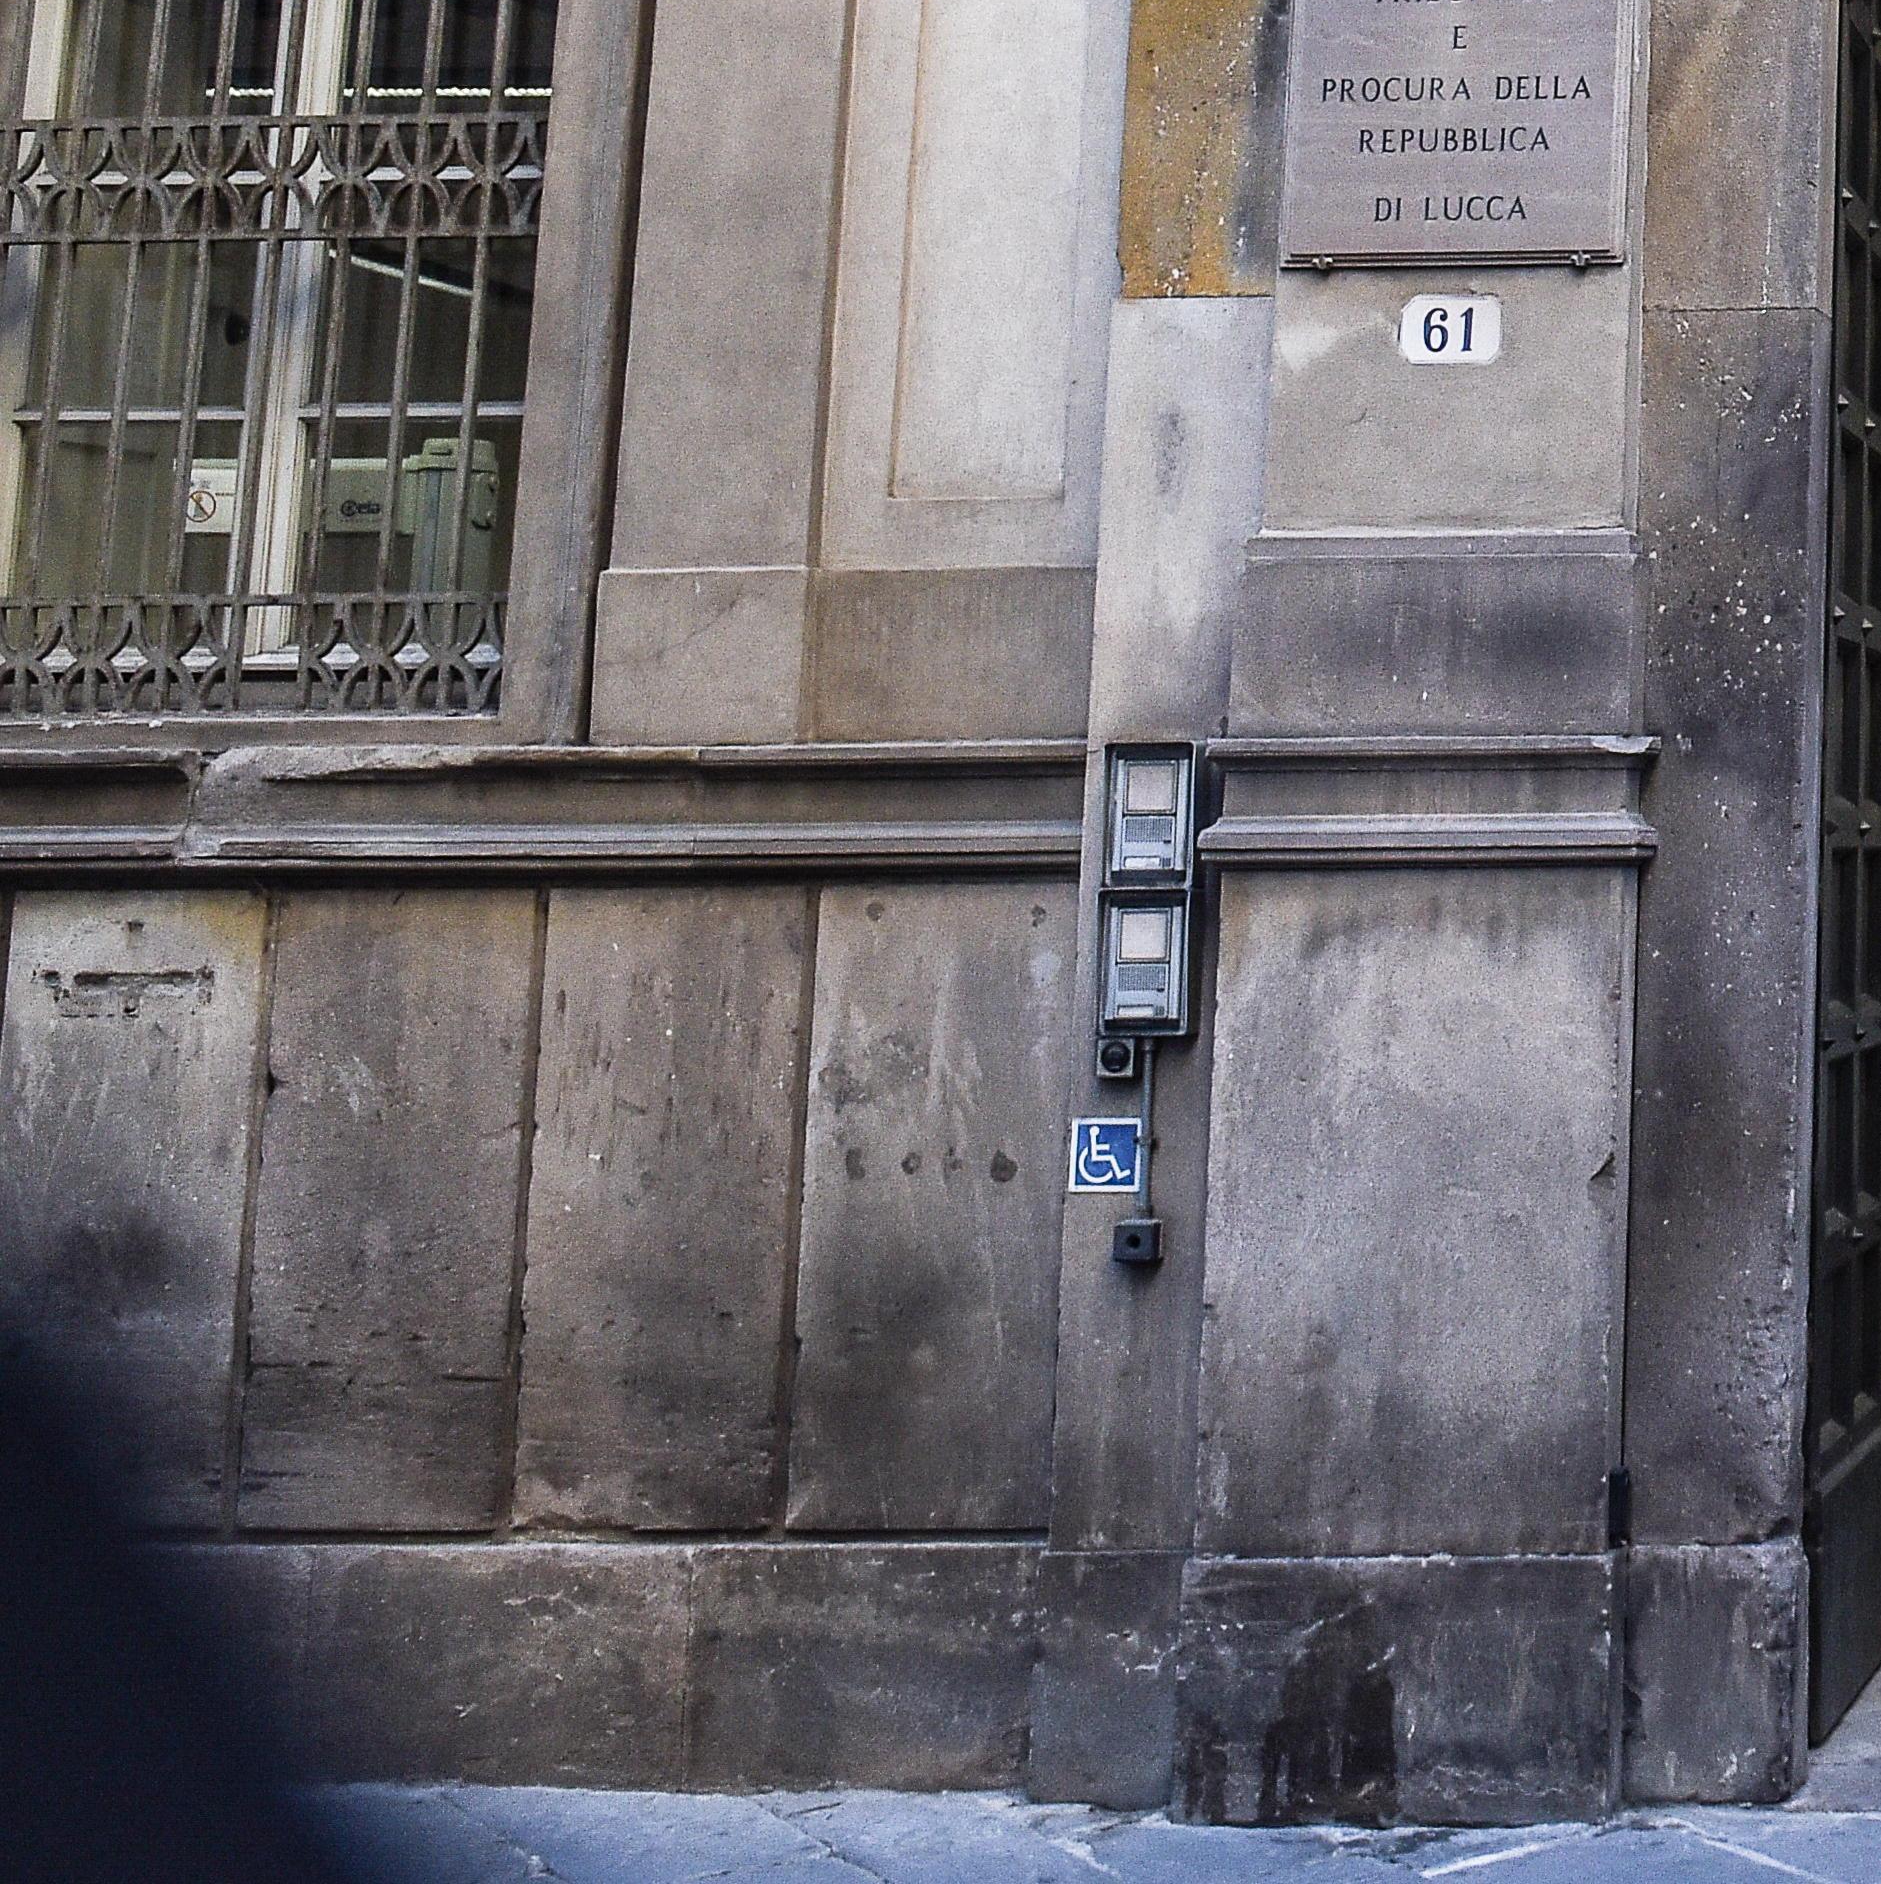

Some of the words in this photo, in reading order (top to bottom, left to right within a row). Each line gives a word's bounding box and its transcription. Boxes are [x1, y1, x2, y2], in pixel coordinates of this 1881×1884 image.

[1452, 25, 1468, 50] E
[1321, 77, 1472, 103] PROCURA
[1494, 74, 1592, 100] DELLA
[1358, 126, 1550, 153] REPUBBLICA
[1373, 197, 1402, 222] DI
[1423, 195, 1528, 221] LUCCA
[1423, 306, 1474, 353] 61
